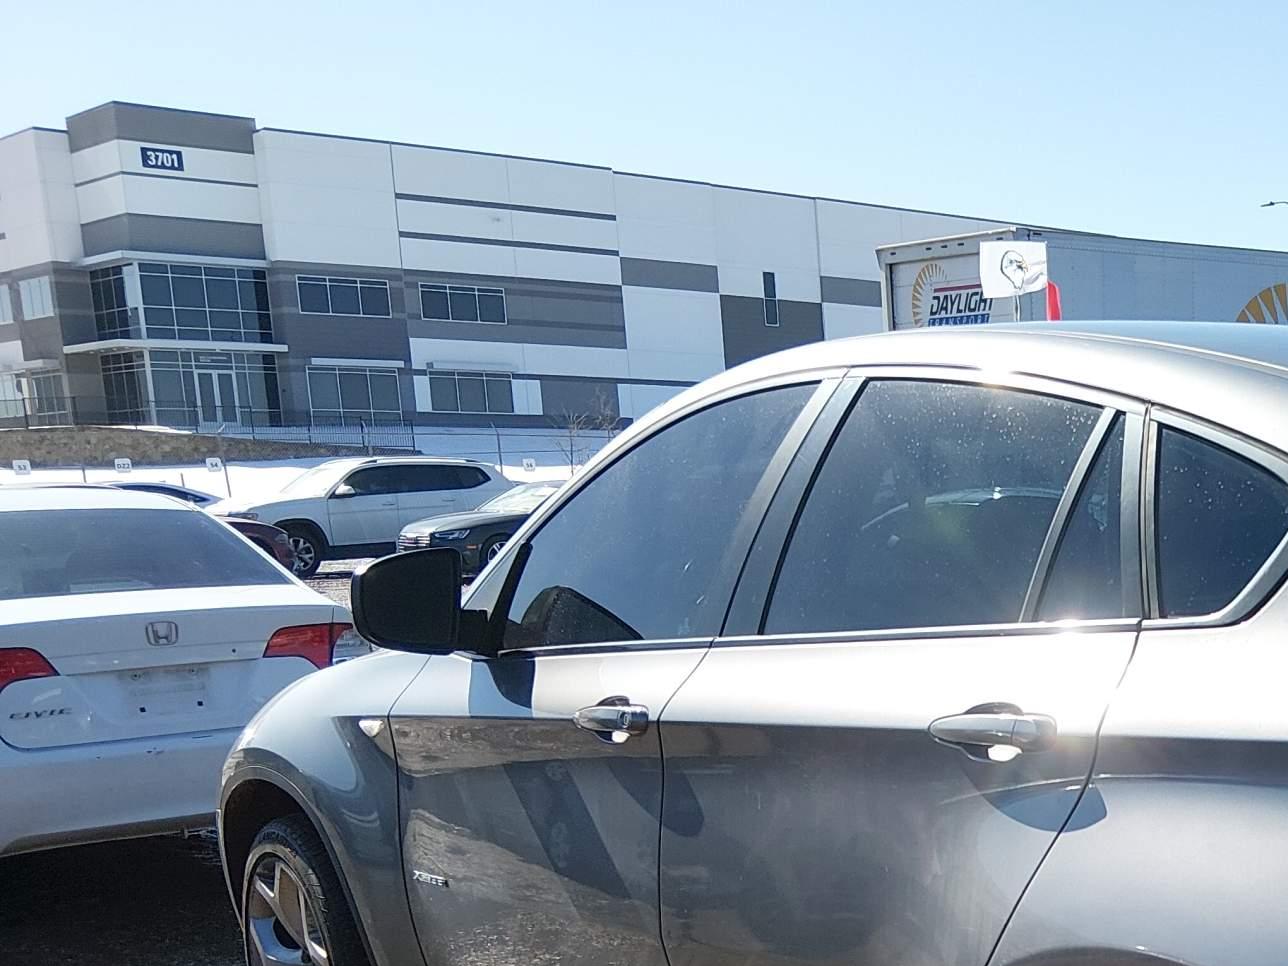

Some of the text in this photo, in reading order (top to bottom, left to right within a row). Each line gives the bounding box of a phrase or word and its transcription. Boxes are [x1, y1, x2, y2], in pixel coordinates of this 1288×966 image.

[146, 151, 179, 168] 3701
[930, 292, 993, 316] DAYLIGHT
[9, 707, 72, 719] CIVIC
